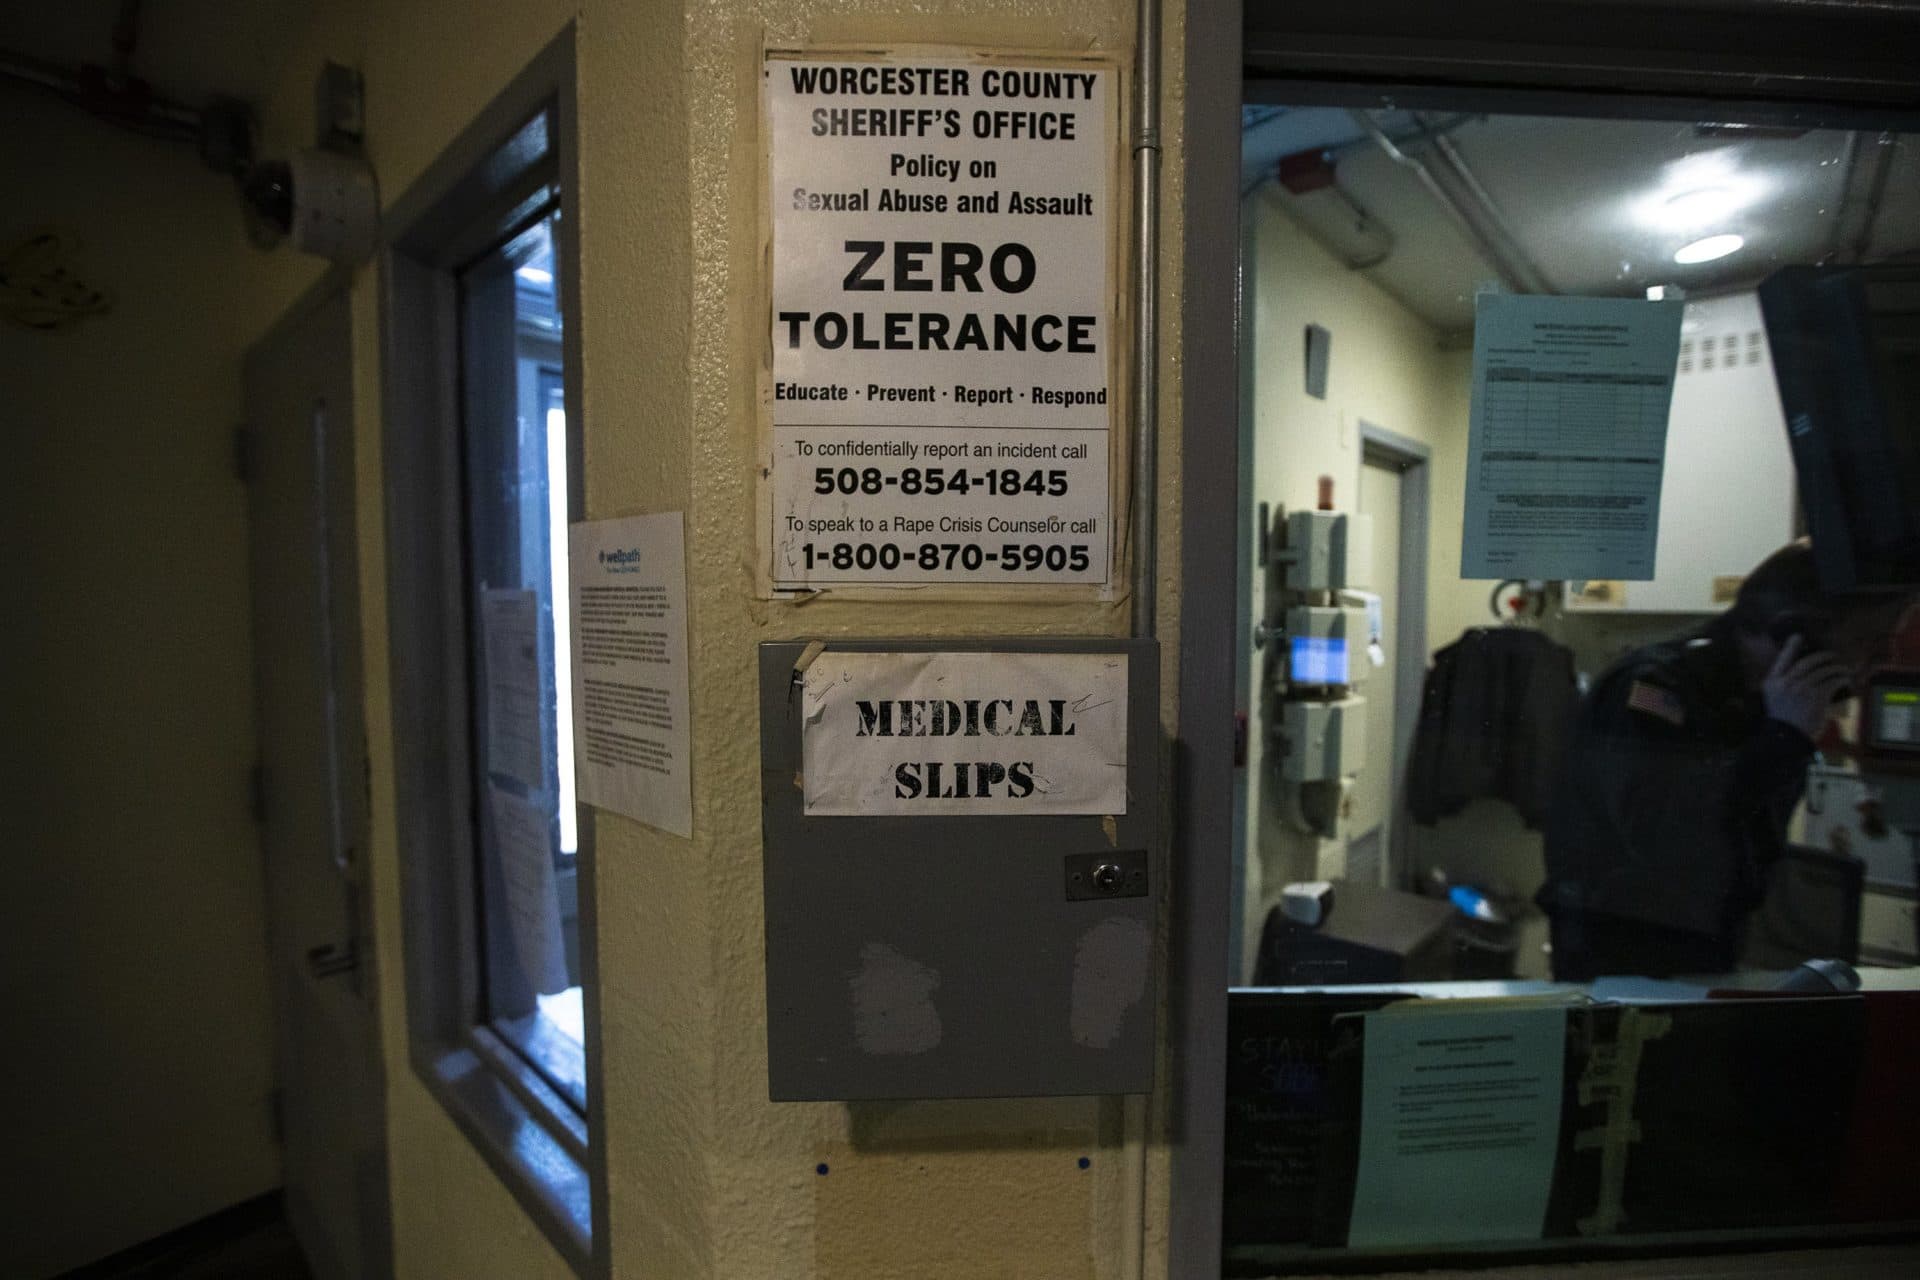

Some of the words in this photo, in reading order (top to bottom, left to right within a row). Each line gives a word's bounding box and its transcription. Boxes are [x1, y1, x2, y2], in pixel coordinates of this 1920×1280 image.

[791, 67, 970, 96] WORCESTER
[982, 69, 1097, 100] COUNTY
[811, 108, 961, 138] SHERIFF'S
[972, 110, 1076, 140] OFFICE
[890, 153, 961, 182] Policy
[969, 160, 997, 178] on
[793, 188, 869, 212] Sexual
[878, 189, 948, 213] Abuse
[957, 191, 999, 214] and
[1008, 191, 1094, 216] Assault
[843, 240, 1037, 294] ZERO
[779, 311, 1097, 353] TOLERANCE
[775, 382, 849, 401] Educate
[867, 384, 936, 403] Prevent
[954, 385, 1013, 408] Report
[1031, 387, 1107, 409] Respond
[795, 440, 814, 457] To
[817, 440, 919, 461] confidentially
[923, 442, 968, 462] report
[973, 444, 993, 458] an
[997, 442, 1057, 459] incident
[1061, 443, 1088, 459] call
[814, 467, 1069, 497] 508-854-1845
[785, 516, 805, 534] To
[808, 516, 855, 536] speak
[859, 517, 875, 533] to
[879, 519, 889, 533] a
[893, 516, 935, 536] Rape
[939, 517, 983, 533] Crisis
[987, 515, 1067, 534] Counselor
[1070, 518, 1097, 534] call
[606, 547, 641, 566] wellpath
[802, 543, 1090, 572] 1-800-870-5905
[855, 699, 1076, 737] MEDICAL
[894, 761, 1035, 800] SLIPS
